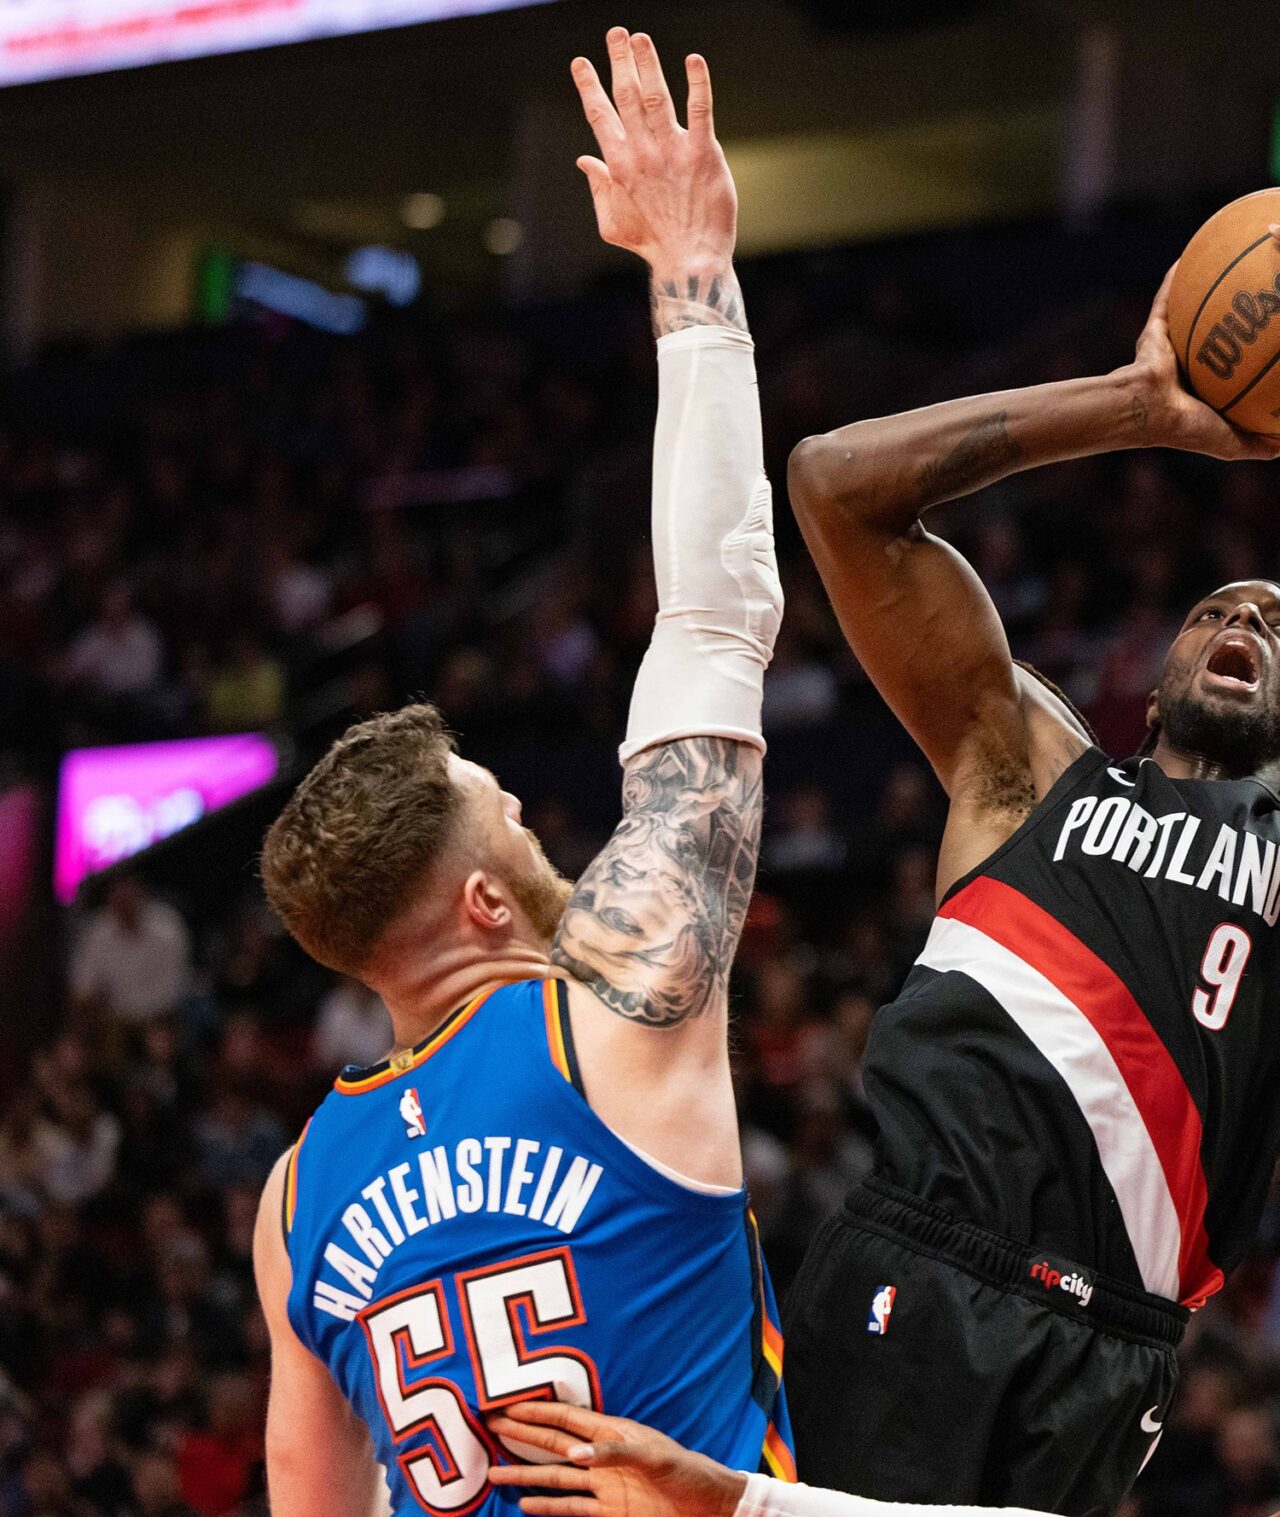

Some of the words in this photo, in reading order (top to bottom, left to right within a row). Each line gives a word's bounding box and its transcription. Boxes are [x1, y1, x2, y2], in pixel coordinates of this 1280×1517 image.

[1191, 922, 1251, 1031] 9
[313, 1136, 604, 1322] HARTENSTEIN
[355, 1246, 604, 1517] 55
